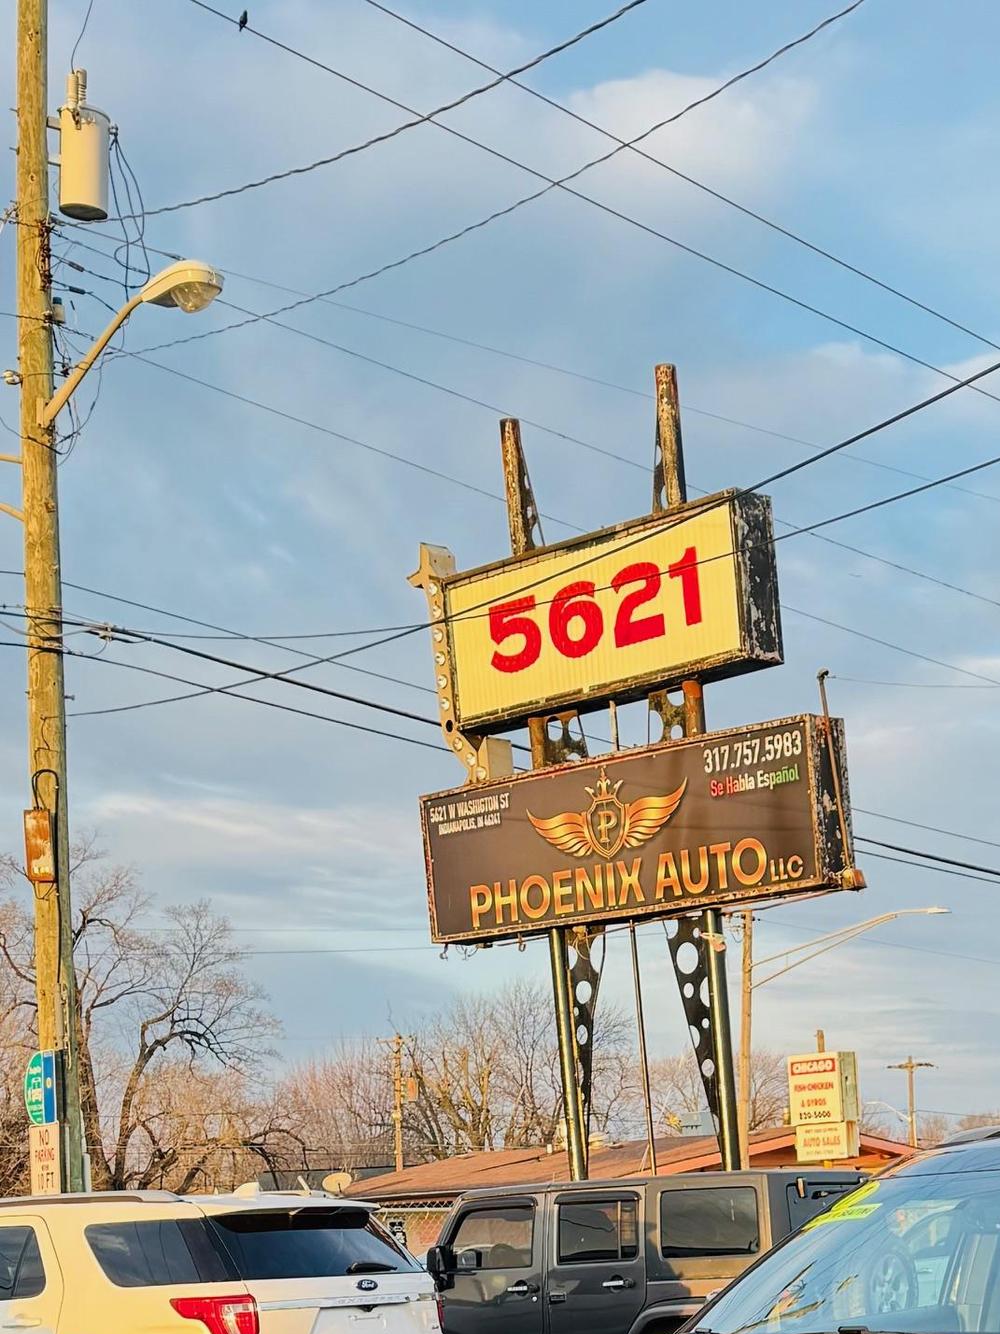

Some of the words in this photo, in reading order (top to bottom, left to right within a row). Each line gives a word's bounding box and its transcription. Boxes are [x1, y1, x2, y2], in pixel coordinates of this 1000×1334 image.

[488, 546, 702, 674] 5621
[703, 730, 802, 774] 317.757.5983
[710, 780, 724, 797] Se
[726, 775, 755, 794] Habla
[757, 763, 800, 790] Español
[430, 806, 447, 823] 5621
[448, 803, 456, 819] W
[500, 793, 510, 809] ST
[477, 815, 485, 828] IN
[470, 857, 645, 928] PHOENIX
[655, 837, 768, 899] AUTO
[770, 855, 804, 882] LLC
[39, 1128, 50, 1146] NO
[35, 1147, 55, 1163] PARKING
[46, 1171, 54, 1189] FT
